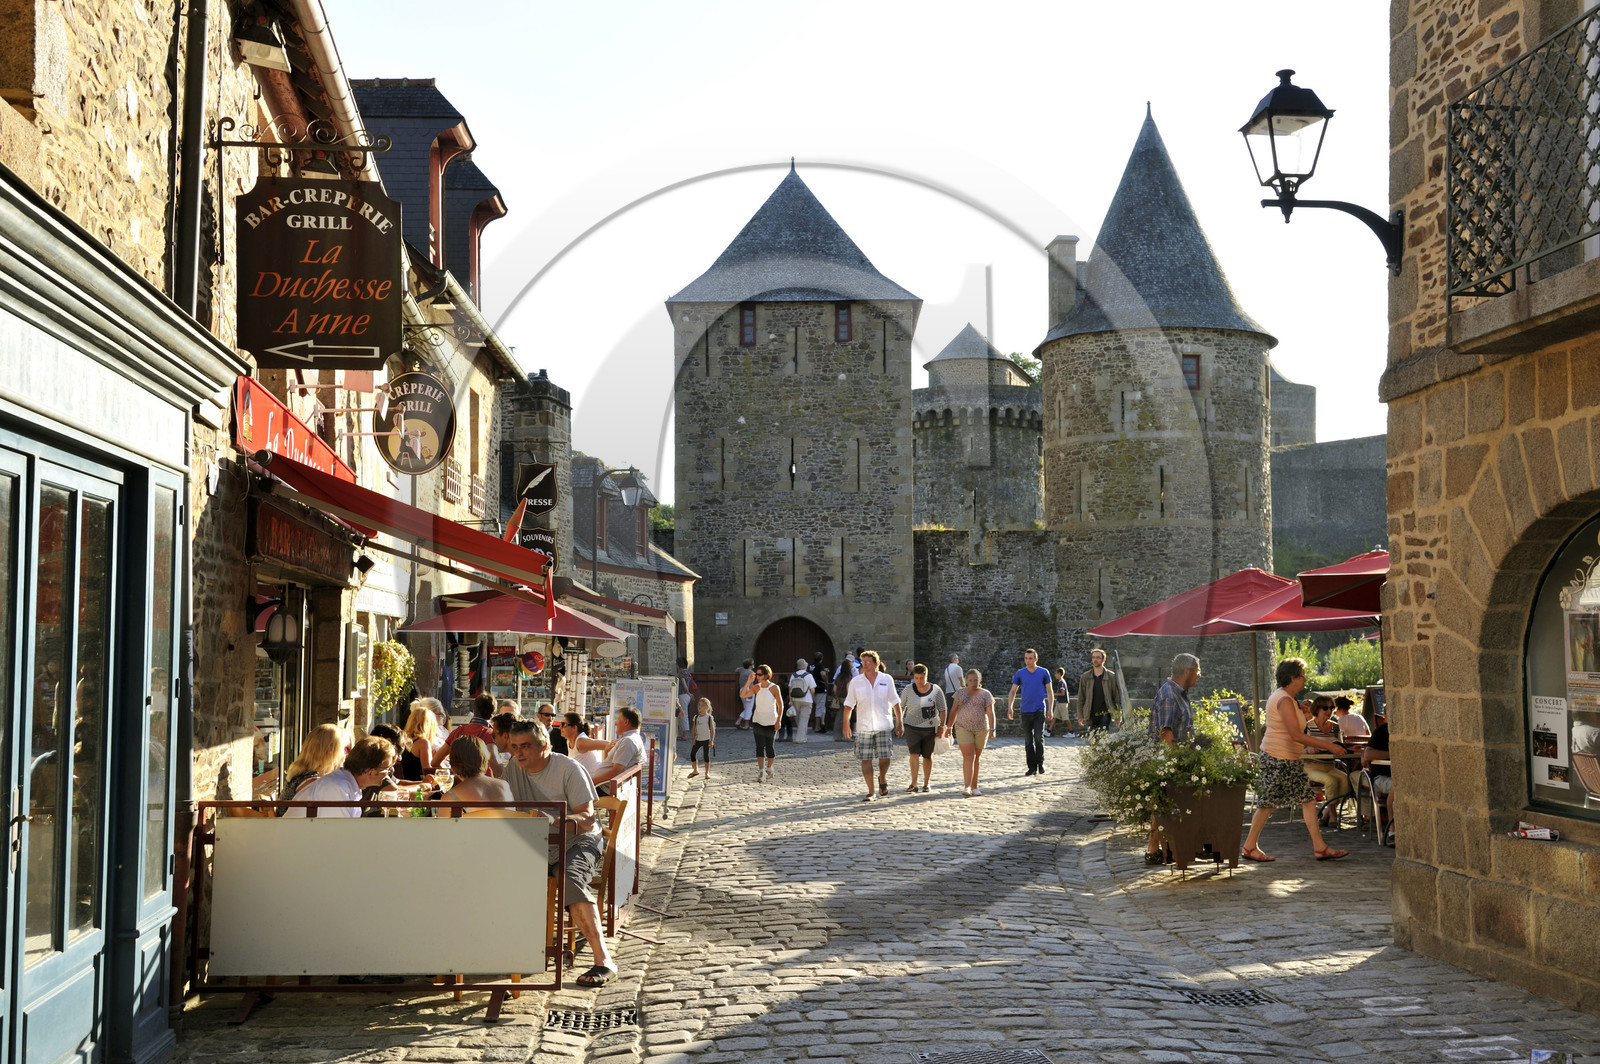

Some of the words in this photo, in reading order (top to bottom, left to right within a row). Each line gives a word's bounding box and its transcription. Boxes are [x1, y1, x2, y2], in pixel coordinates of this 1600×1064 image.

[244, 188, 393, 235] BAR-CREPERIE
[286, 214, 353, 231] GRILL
[299, 239, 344, 265] La
[249, 269, 392, 304] Duchesse
[272, 308, 371, 336] Anne
[389, 381, 445, 403] CRÊPERIE
[527, 498, 553, 506] RESSE
[522, 533, 555, 545] SOUVENIRS
[1534, 697, 1562, 707] CONCERT
